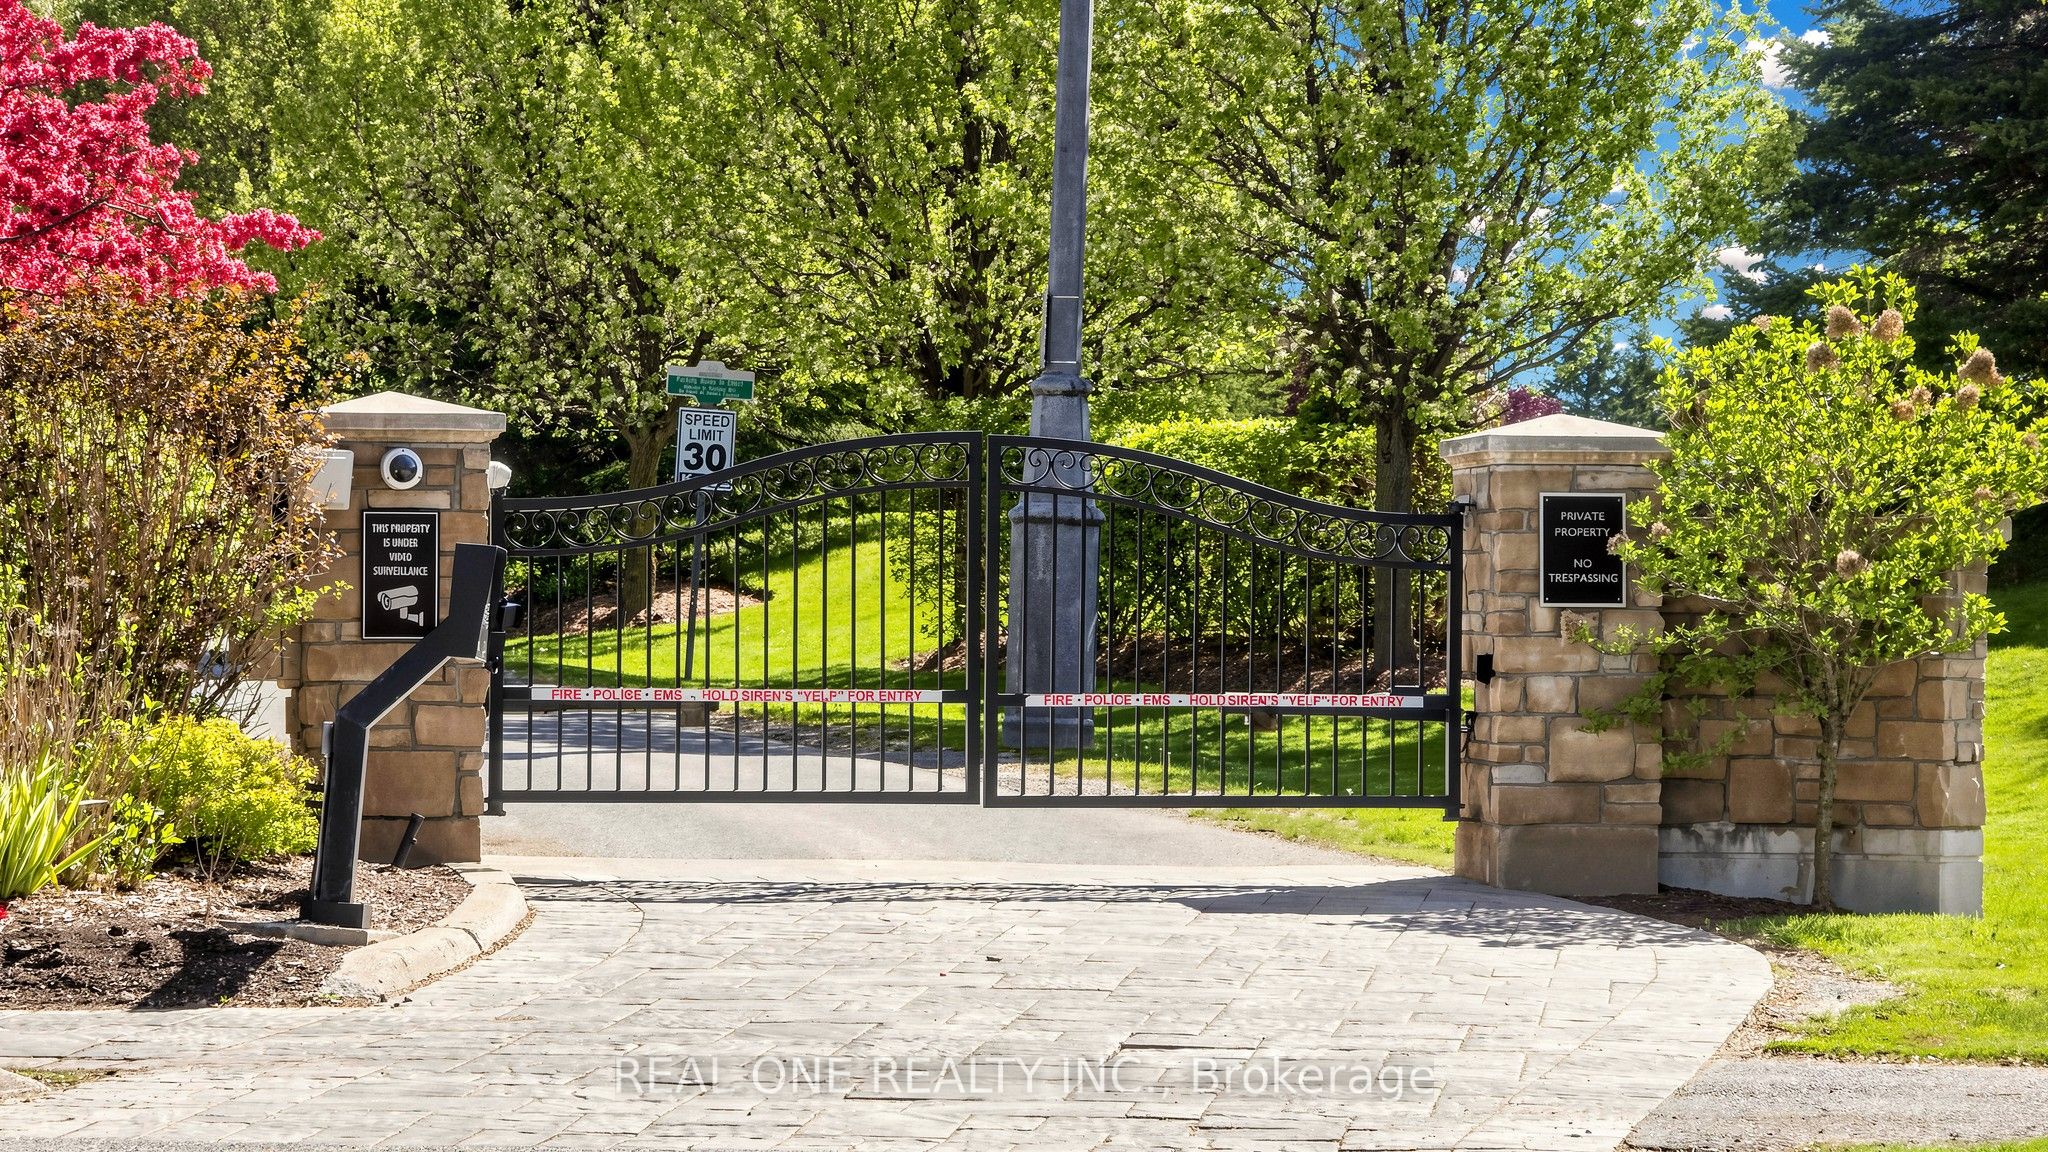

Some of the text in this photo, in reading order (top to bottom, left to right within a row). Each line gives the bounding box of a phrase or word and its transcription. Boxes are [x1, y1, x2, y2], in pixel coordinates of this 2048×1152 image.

[685, 413, 730, 428] SPEED
[689, 428, 724, 441] LIMIT
[683, 442, 726, 471] 30
[1560, 511, 1606, 521] PRIVATE
[372, 523, 430, 533] THIS PROPERTY
[1554, 527, 1611, 537] PROPERTY
[383, 538, 419, 548] IS UNDER
[389, 552, 412, 562] VIDEO
[1573, 559, 1593, 569] NO
[373, 566, 429, 576] SURVEILLANCE
[1548, 573, 1619, 583] TRESPASSING
[551, 689, 581, 700] FIRE
[593, 689, 642, 700] POLICE
[654, 690, 682, 700] EMS
[702, 690, 739, 701] HOLD
[741, 690, 793, 702] SIREN'S
[848, 691, 874, 702] FOR
[879, 691, 922, 702] ENTRY
[1044, 695, 1073, 706] FIRE
[1084, 695, 1132, 706] POLICE
[1143, 695, 1171, 705] EMS
[1189, 695, 1226, 706] HOLD
[1228, 695, 1279, 706] SIREN'S
[1331, 696, 1358, 707] FOR
[1361, 696, 1404, 707] ENTRY
